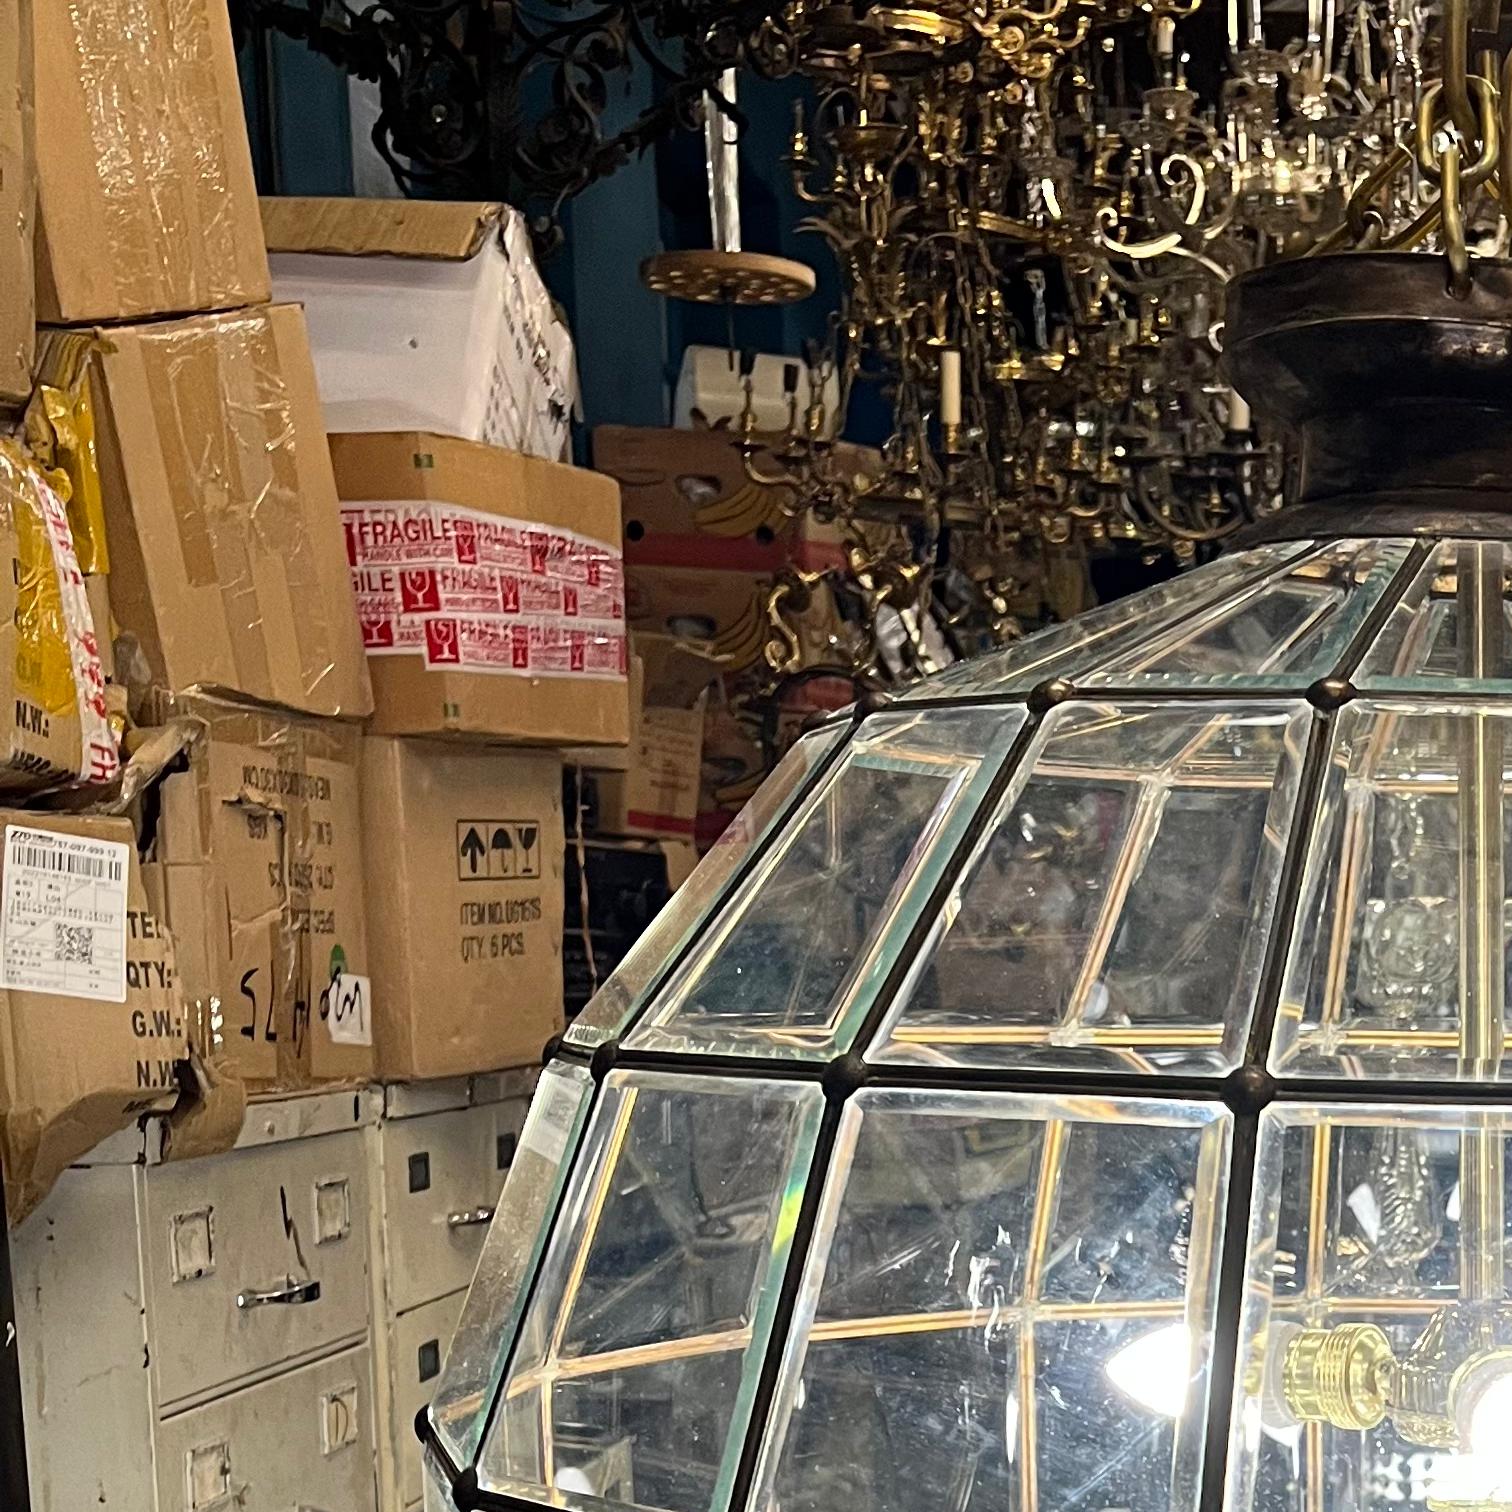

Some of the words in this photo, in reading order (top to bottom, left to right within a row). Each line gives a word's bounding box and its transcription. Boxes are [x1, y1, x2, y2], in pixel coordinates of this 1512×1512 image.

[359, 518, 453, 546] FRAGILE
[126, 960, 172, 990] QTY:
[132, 1009, 182, 1038] G.W.:
